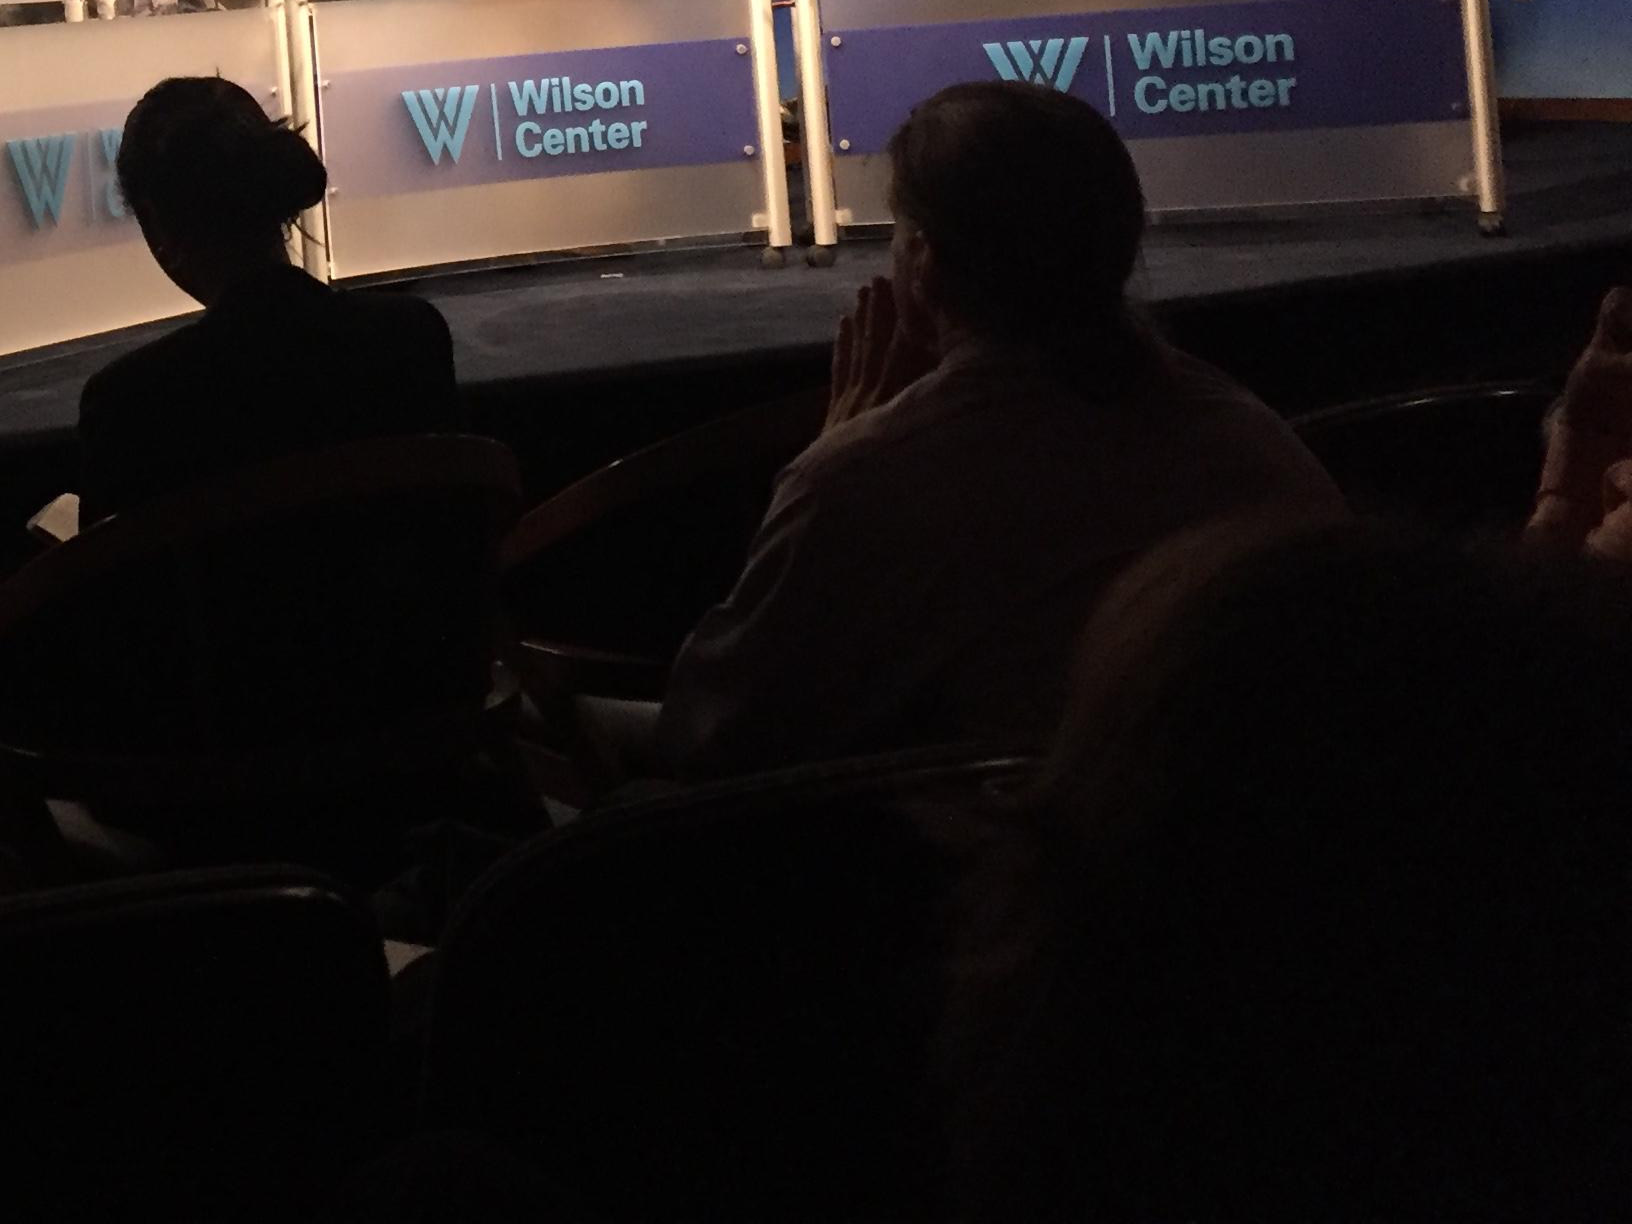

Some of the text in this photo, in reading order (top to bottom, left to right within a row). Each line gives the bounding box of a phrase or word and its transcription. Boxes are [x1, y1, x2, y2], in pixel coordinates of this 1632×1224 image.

[1127, 29, 1295, 70] Wilson
[507, 76, 646, 117] Wilson
[1134, 74, 1297, 114] Center
[515, 118, 648, 159] Center
